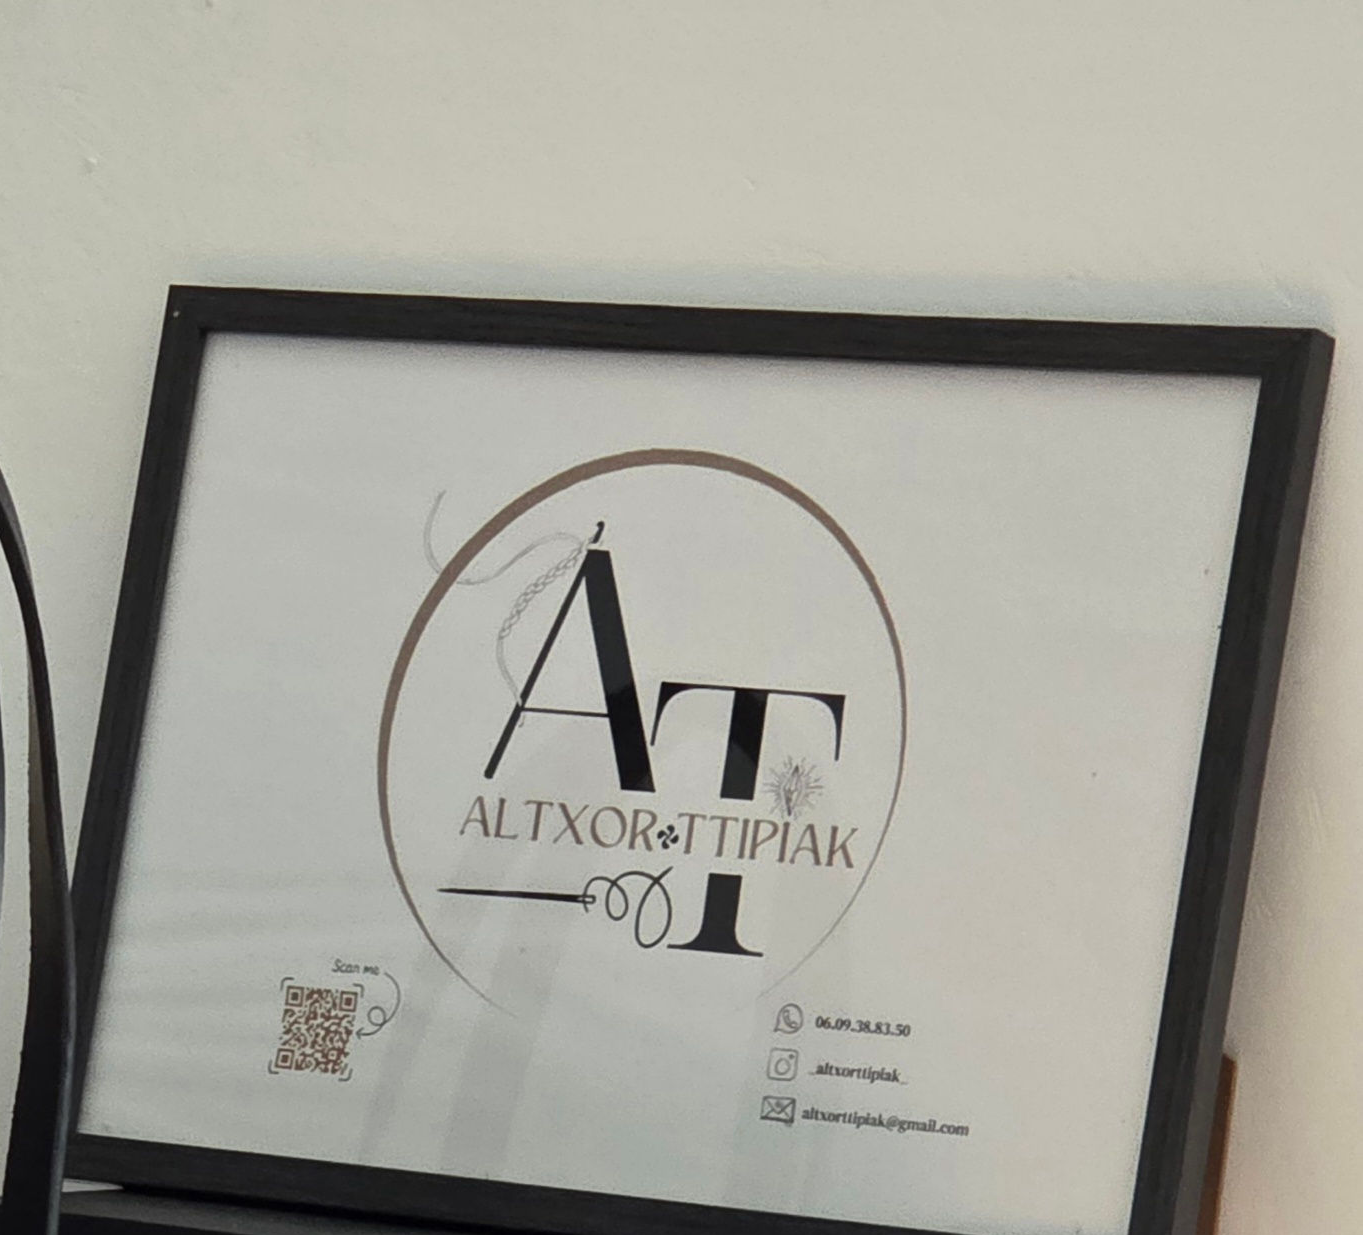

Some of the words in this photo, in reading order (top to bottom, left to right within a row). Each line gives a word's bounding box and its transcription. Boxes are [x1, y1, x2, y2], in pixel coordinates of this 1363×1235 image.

[331, 958, 360, 974] Scan
[362, 965, 381, 976] me
[815, 1015, 911, 1037] 06.09.38.83.50
[801, 1107, 969, 1136] altxorttipiak@gmail.com
